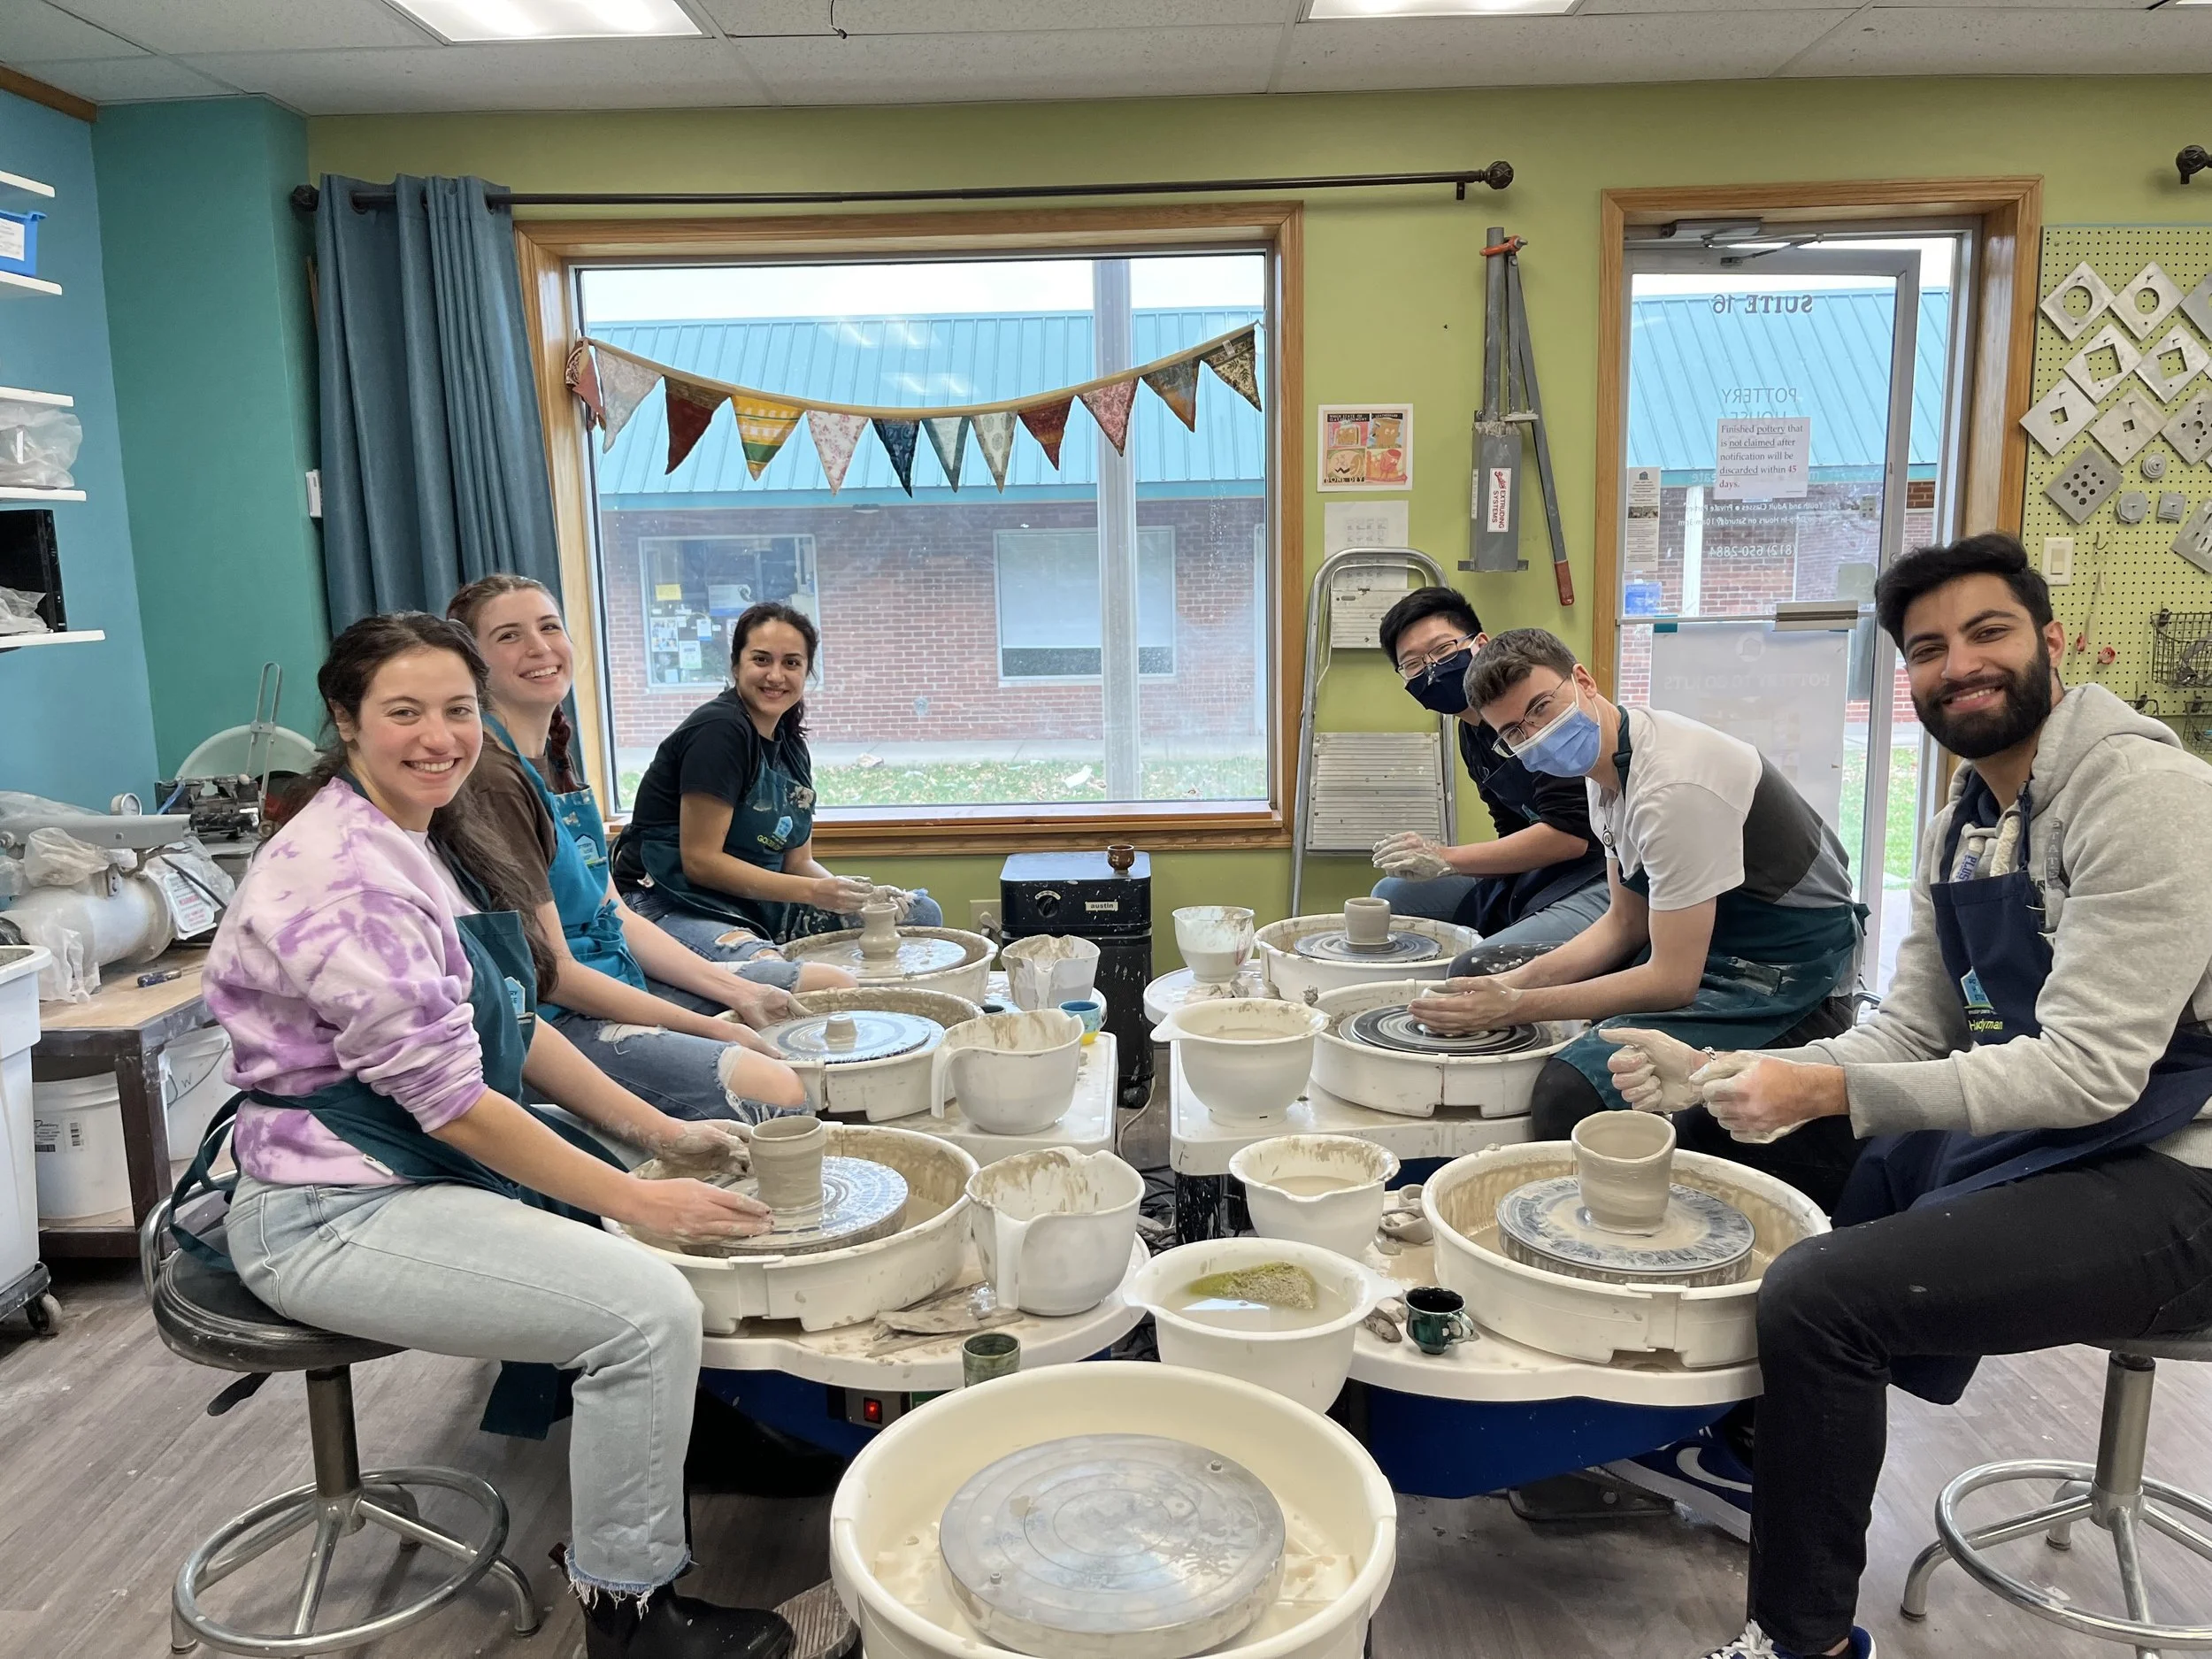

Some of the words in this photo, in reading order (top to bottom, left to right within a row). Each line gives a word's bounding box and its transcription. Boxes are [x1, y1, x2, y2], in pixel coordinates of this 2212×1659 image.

[1721, 425, 1755, 434] Finished
[1756, 425, 1786, 435] pottery
[1787, 424, 1803, 433] that
[1743, 438, 1775, 447] claimed
[1777, 438, 1795, 447] after
[1720, 451, 1765, 460] notification
[1767, 451, 1783, 460] will
[1784, 451, 1793, 460] be
[1719, 465, 1758, 474] discarded
[1760, 465, 1786, 474] within
[1788, 465, 1797, 473] 45
[1719, 480, 1740, 490] days.
